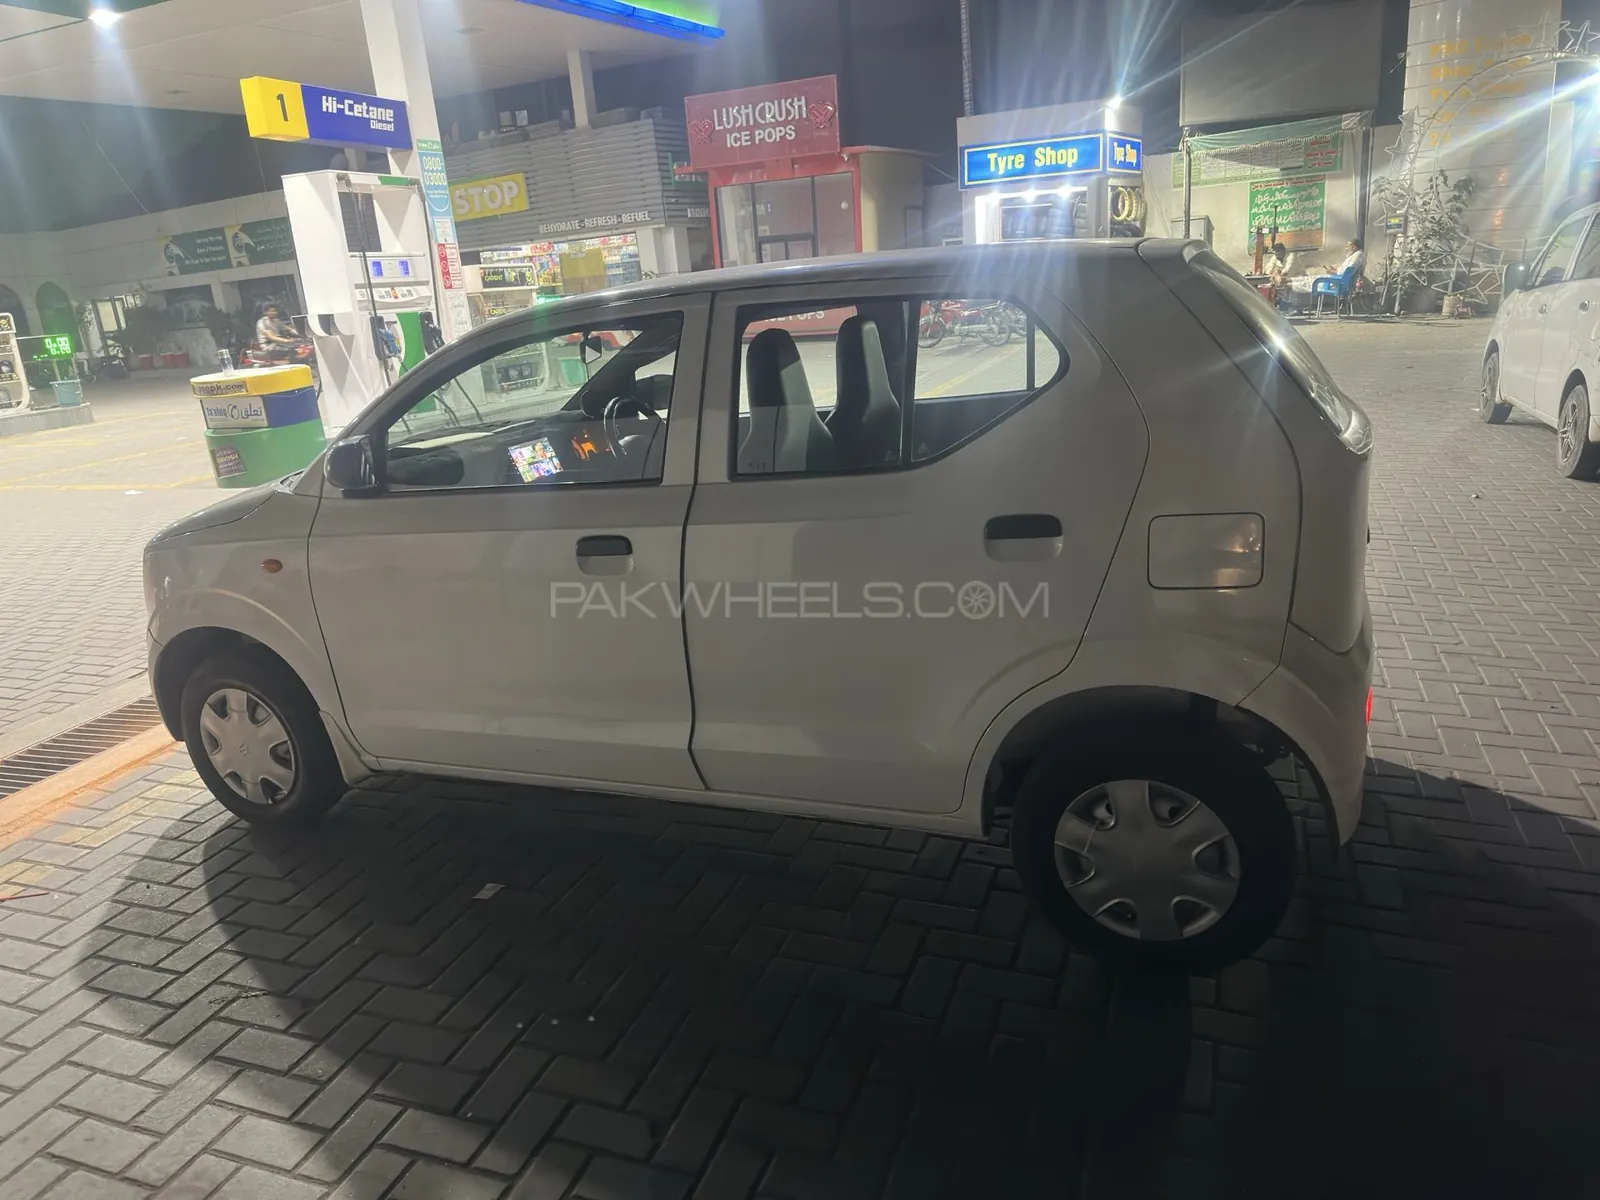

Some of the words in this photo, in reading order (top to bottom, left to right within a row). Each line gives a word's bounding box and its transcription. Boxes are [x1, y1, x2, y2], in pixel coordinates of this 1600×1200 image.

[276, 93, 289, 122] 1
[321, 95, 394, 122] Hi-Cetane
[713, 103, 752, 131] LUSH
[755, 96, 807, 125] CRUSH
[370, 119, 395, 132] Diesel
[726, 130, 751, 148] ICE
[755, 125, 796, 145] POPS
[987, 152, 1025, 175] Tyre
[1034, 147, 1078, 169] Shop
[453, 181, 519, 215] STOP
[539, 219, 581, 234] REHYDRATE
[585, 215, 617, 229] REFRESH
[622, 211, 651, 225] REFUEL
